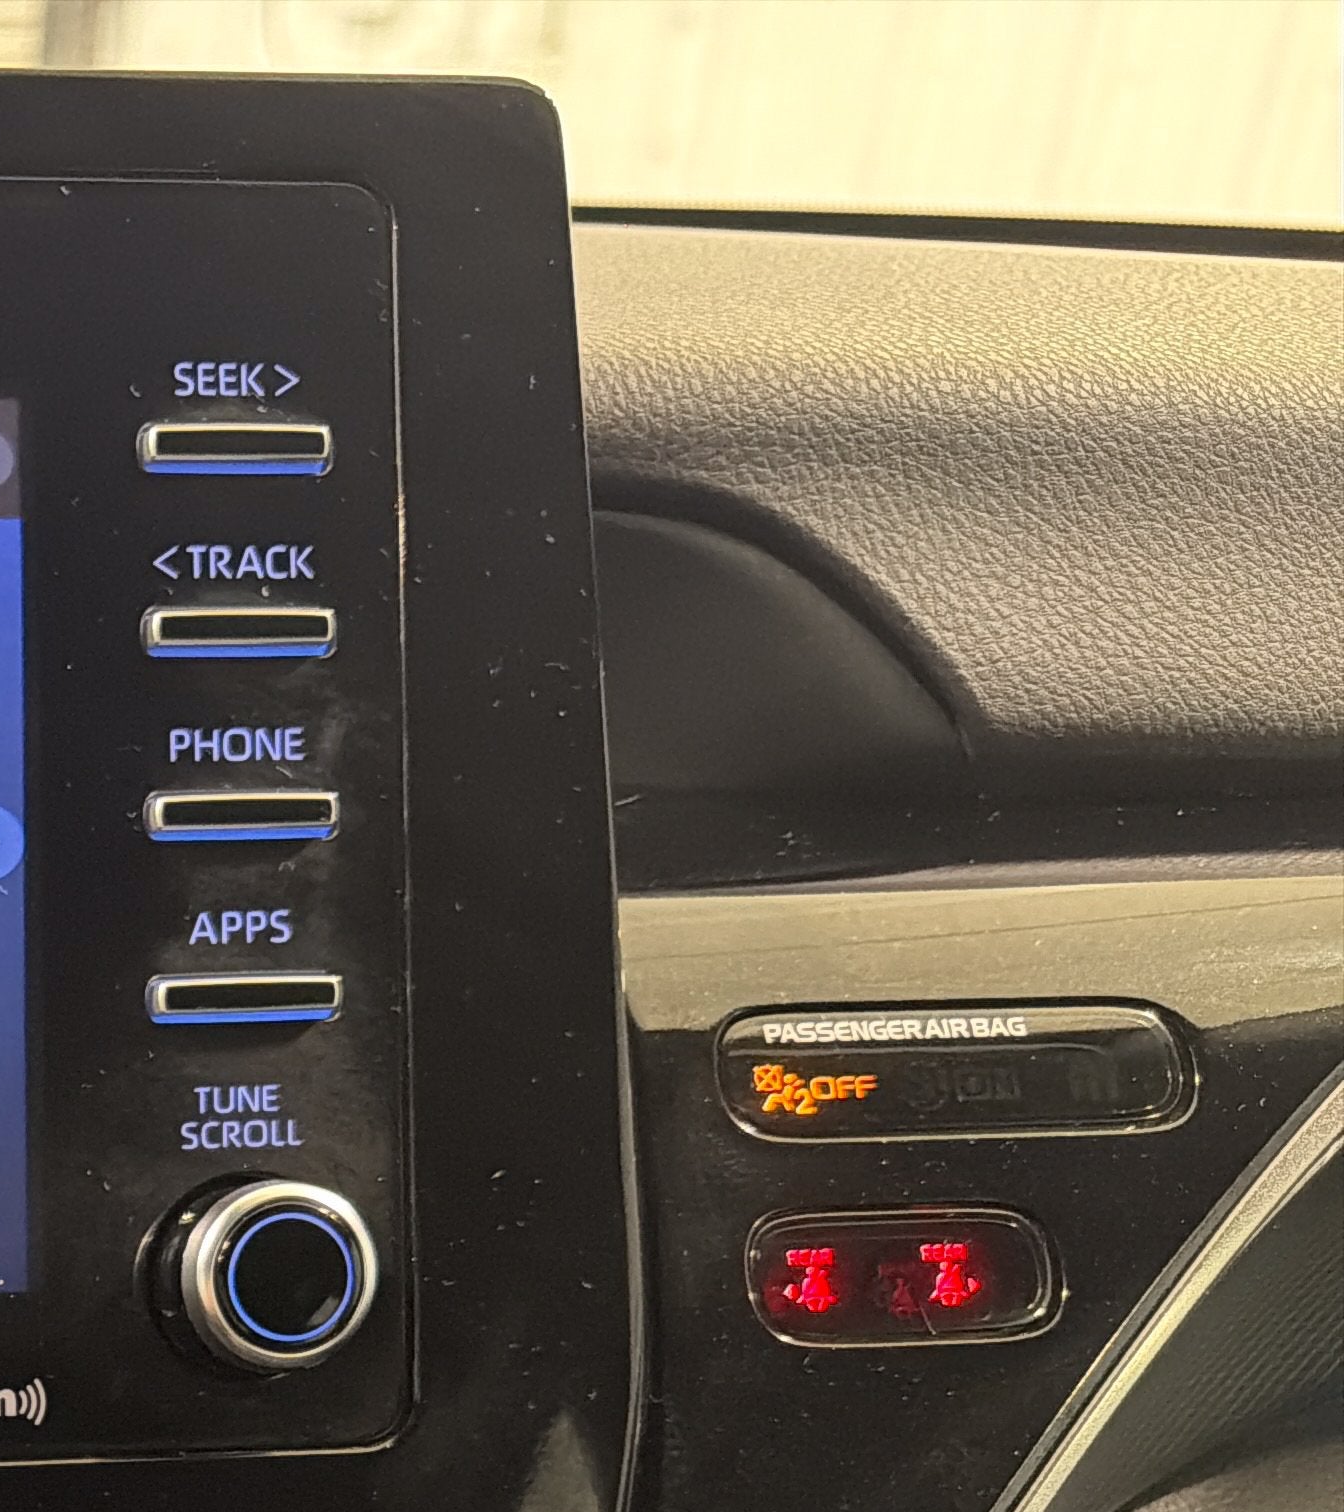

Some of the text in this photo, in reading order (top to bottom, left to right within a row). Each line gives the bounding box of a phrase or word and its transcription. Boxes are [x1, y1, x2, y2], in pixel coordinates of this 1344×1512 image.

[173, 361, 265, 398] SEEK
[185, 544, 314, 580] TRACK
[169, 727, 306, 763] PHONE
[188, 909, 292, 945] APPS
[762, 1019, 924, 1044] PASSENGER
[969, 1016, 1027, 1038] BAG
[193, 1084, 281, 1114] TUNE
[809, 1073, 879, 1101] OFF
[180, 1119, 303, 1150] SCROLL
